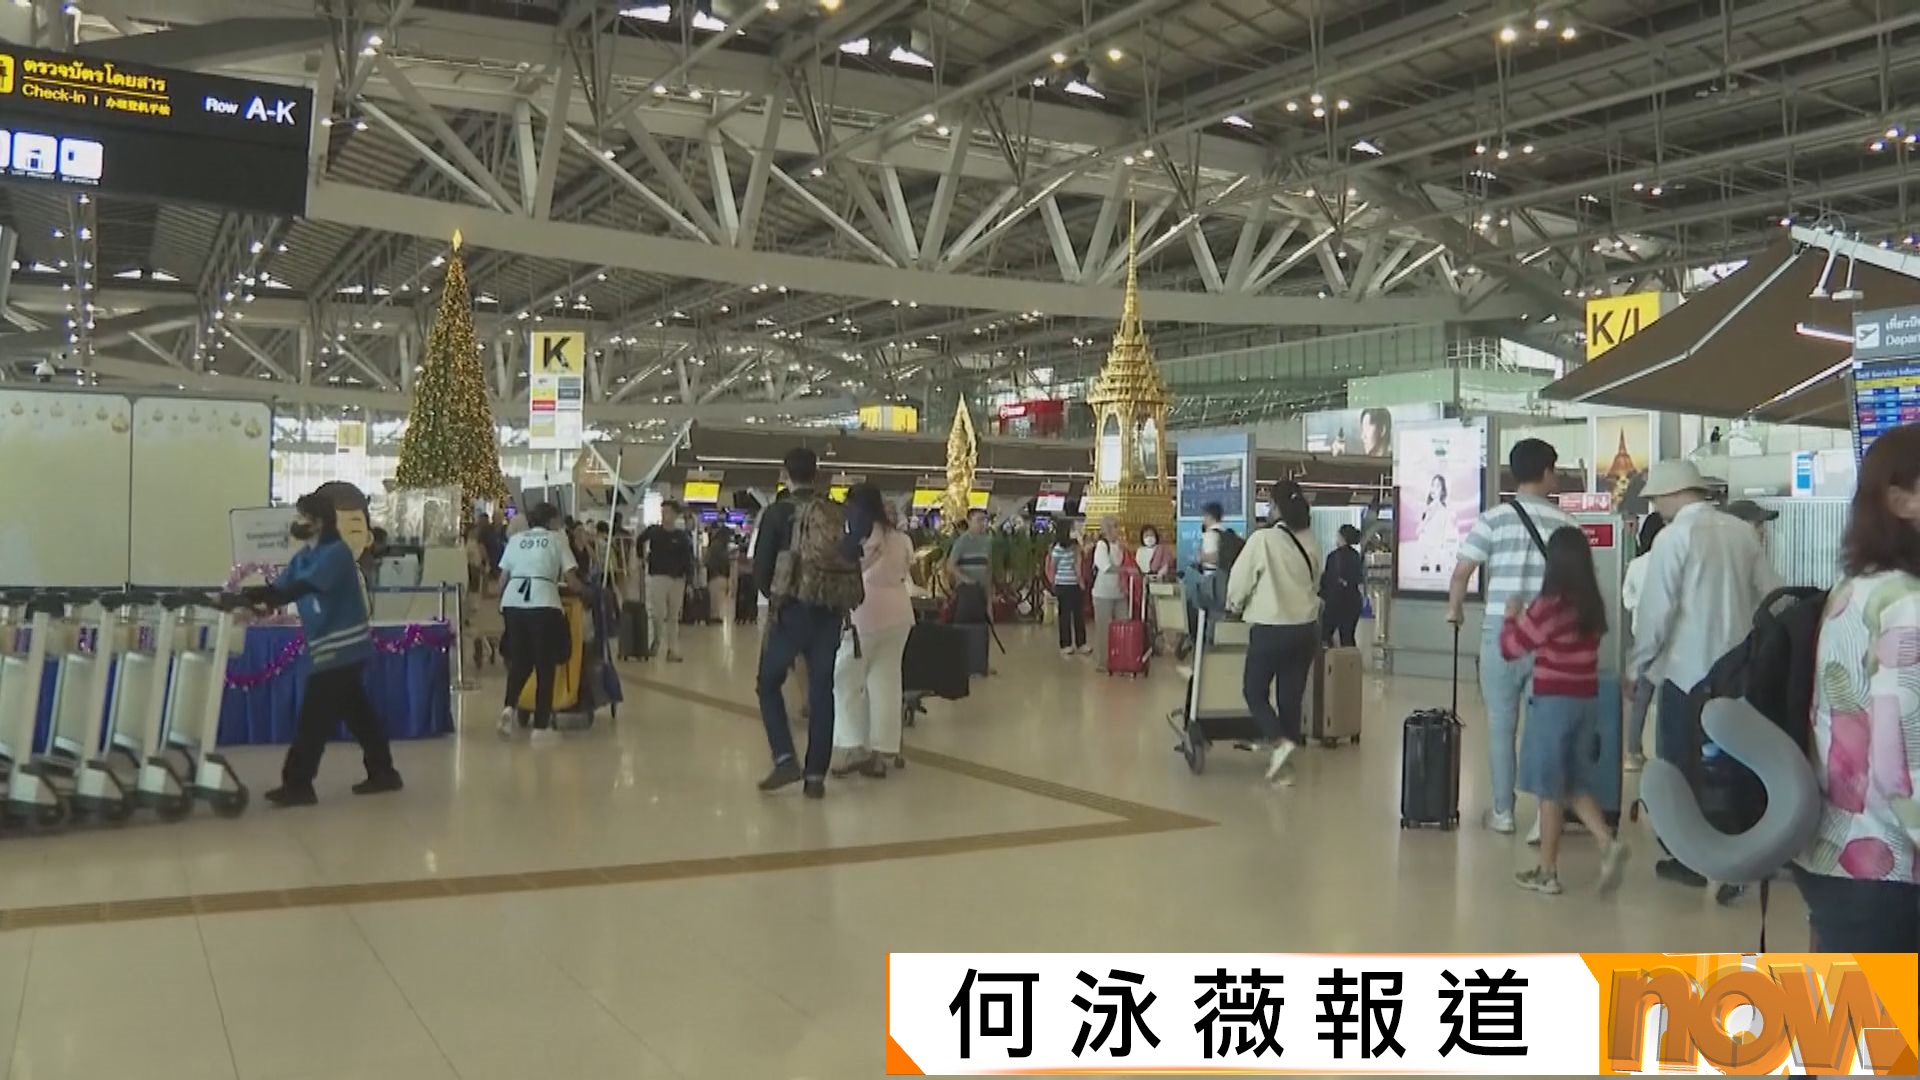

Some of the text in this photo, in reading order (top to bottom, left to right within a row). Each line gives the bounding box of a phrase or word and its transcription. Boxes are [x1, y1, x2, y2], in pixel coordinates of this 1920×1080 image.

[22, 84, 87, 104] Check-in
[205, 96, 297, 125] Row A-K
[544, 336, 571, 368] K
[520, 539, 549, 549] 0910
